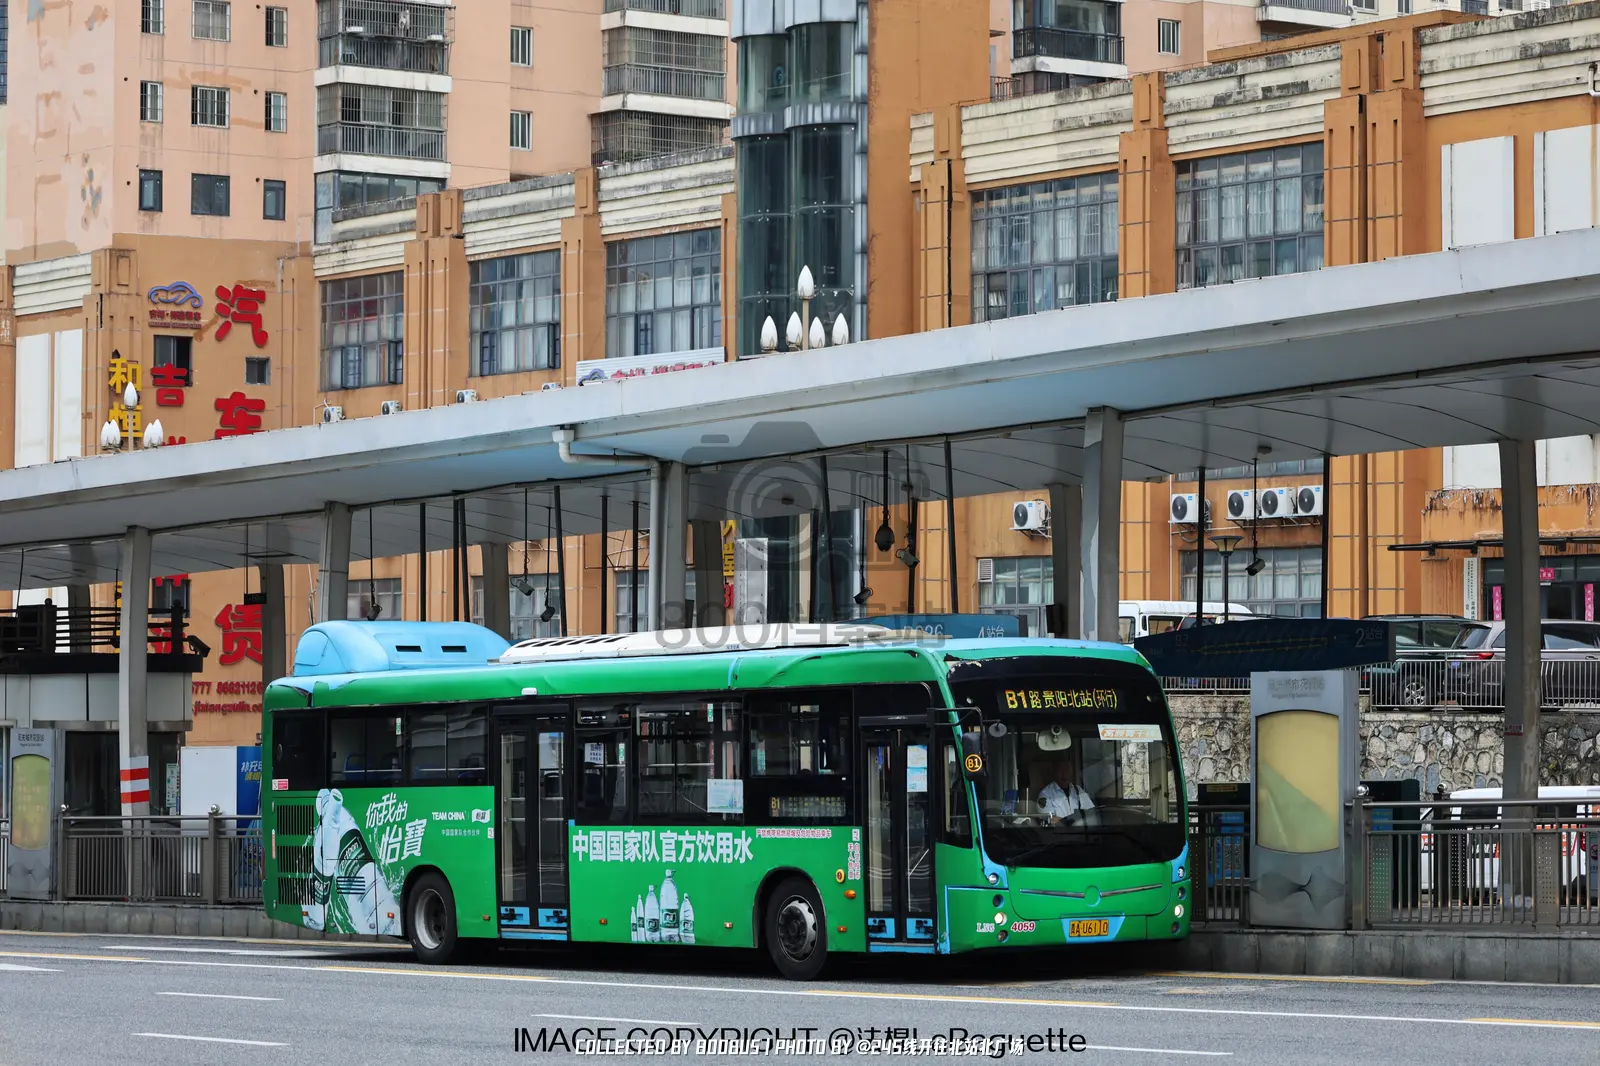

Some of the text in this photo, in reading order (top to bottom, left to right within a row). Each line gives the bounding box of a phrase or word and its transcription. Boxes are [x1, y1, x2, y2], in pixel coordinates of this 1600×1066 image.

[151, 363, 188, 406] 吉
[215, 604, 262, 665] 赁
[967, 758, 981, 770] B1
[366, 792, 408, 829] 你我的
[431, 811, 465, 821] TEAM CHINA
[572, 830, 754, 864] 中国国家队官方饮用水
[1011, 921, 1035, 932] 4059
